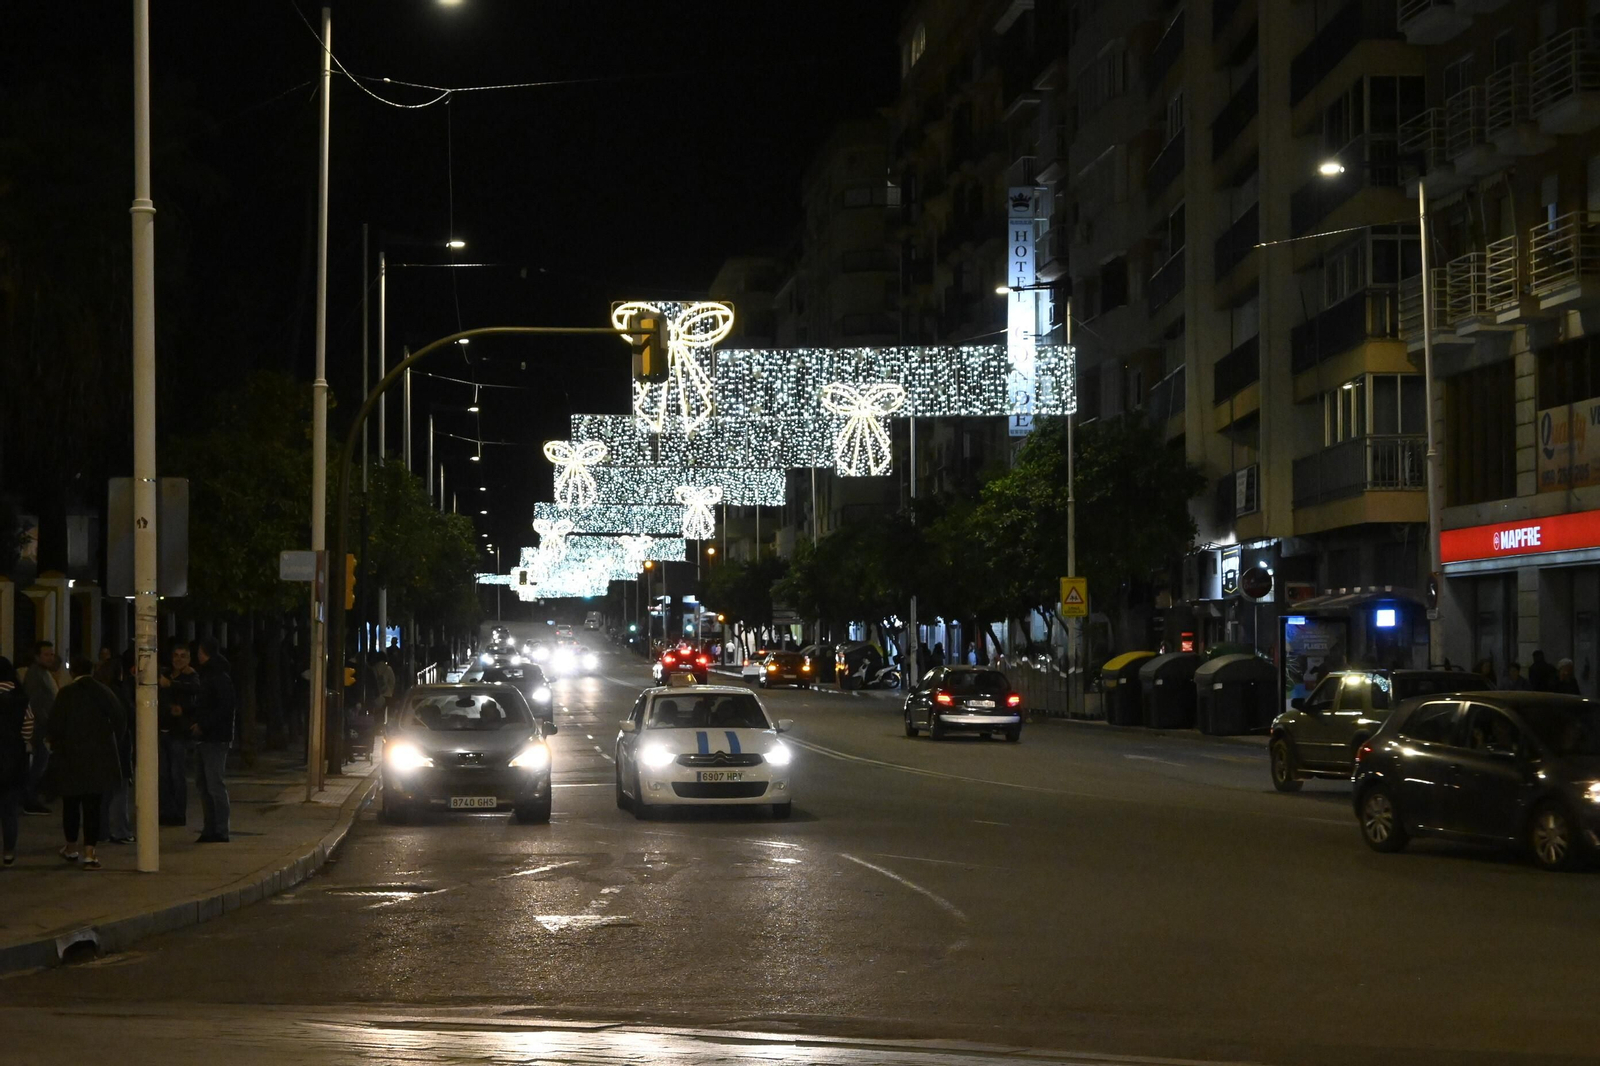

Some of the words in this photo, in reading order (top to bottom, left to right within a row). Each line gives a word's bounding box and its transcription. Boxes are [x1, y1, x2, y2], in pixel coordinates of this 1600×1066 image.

[1014, 231, 1027, 303] HOTEL
[1500, 526, 1541, 550] MAPFRE
[702, 772, 724, 781] 6907
[726, 772, 743, 781] HPY
[452, 798, 475, 807] 8740
[477, 798, 494, 807] GHS
